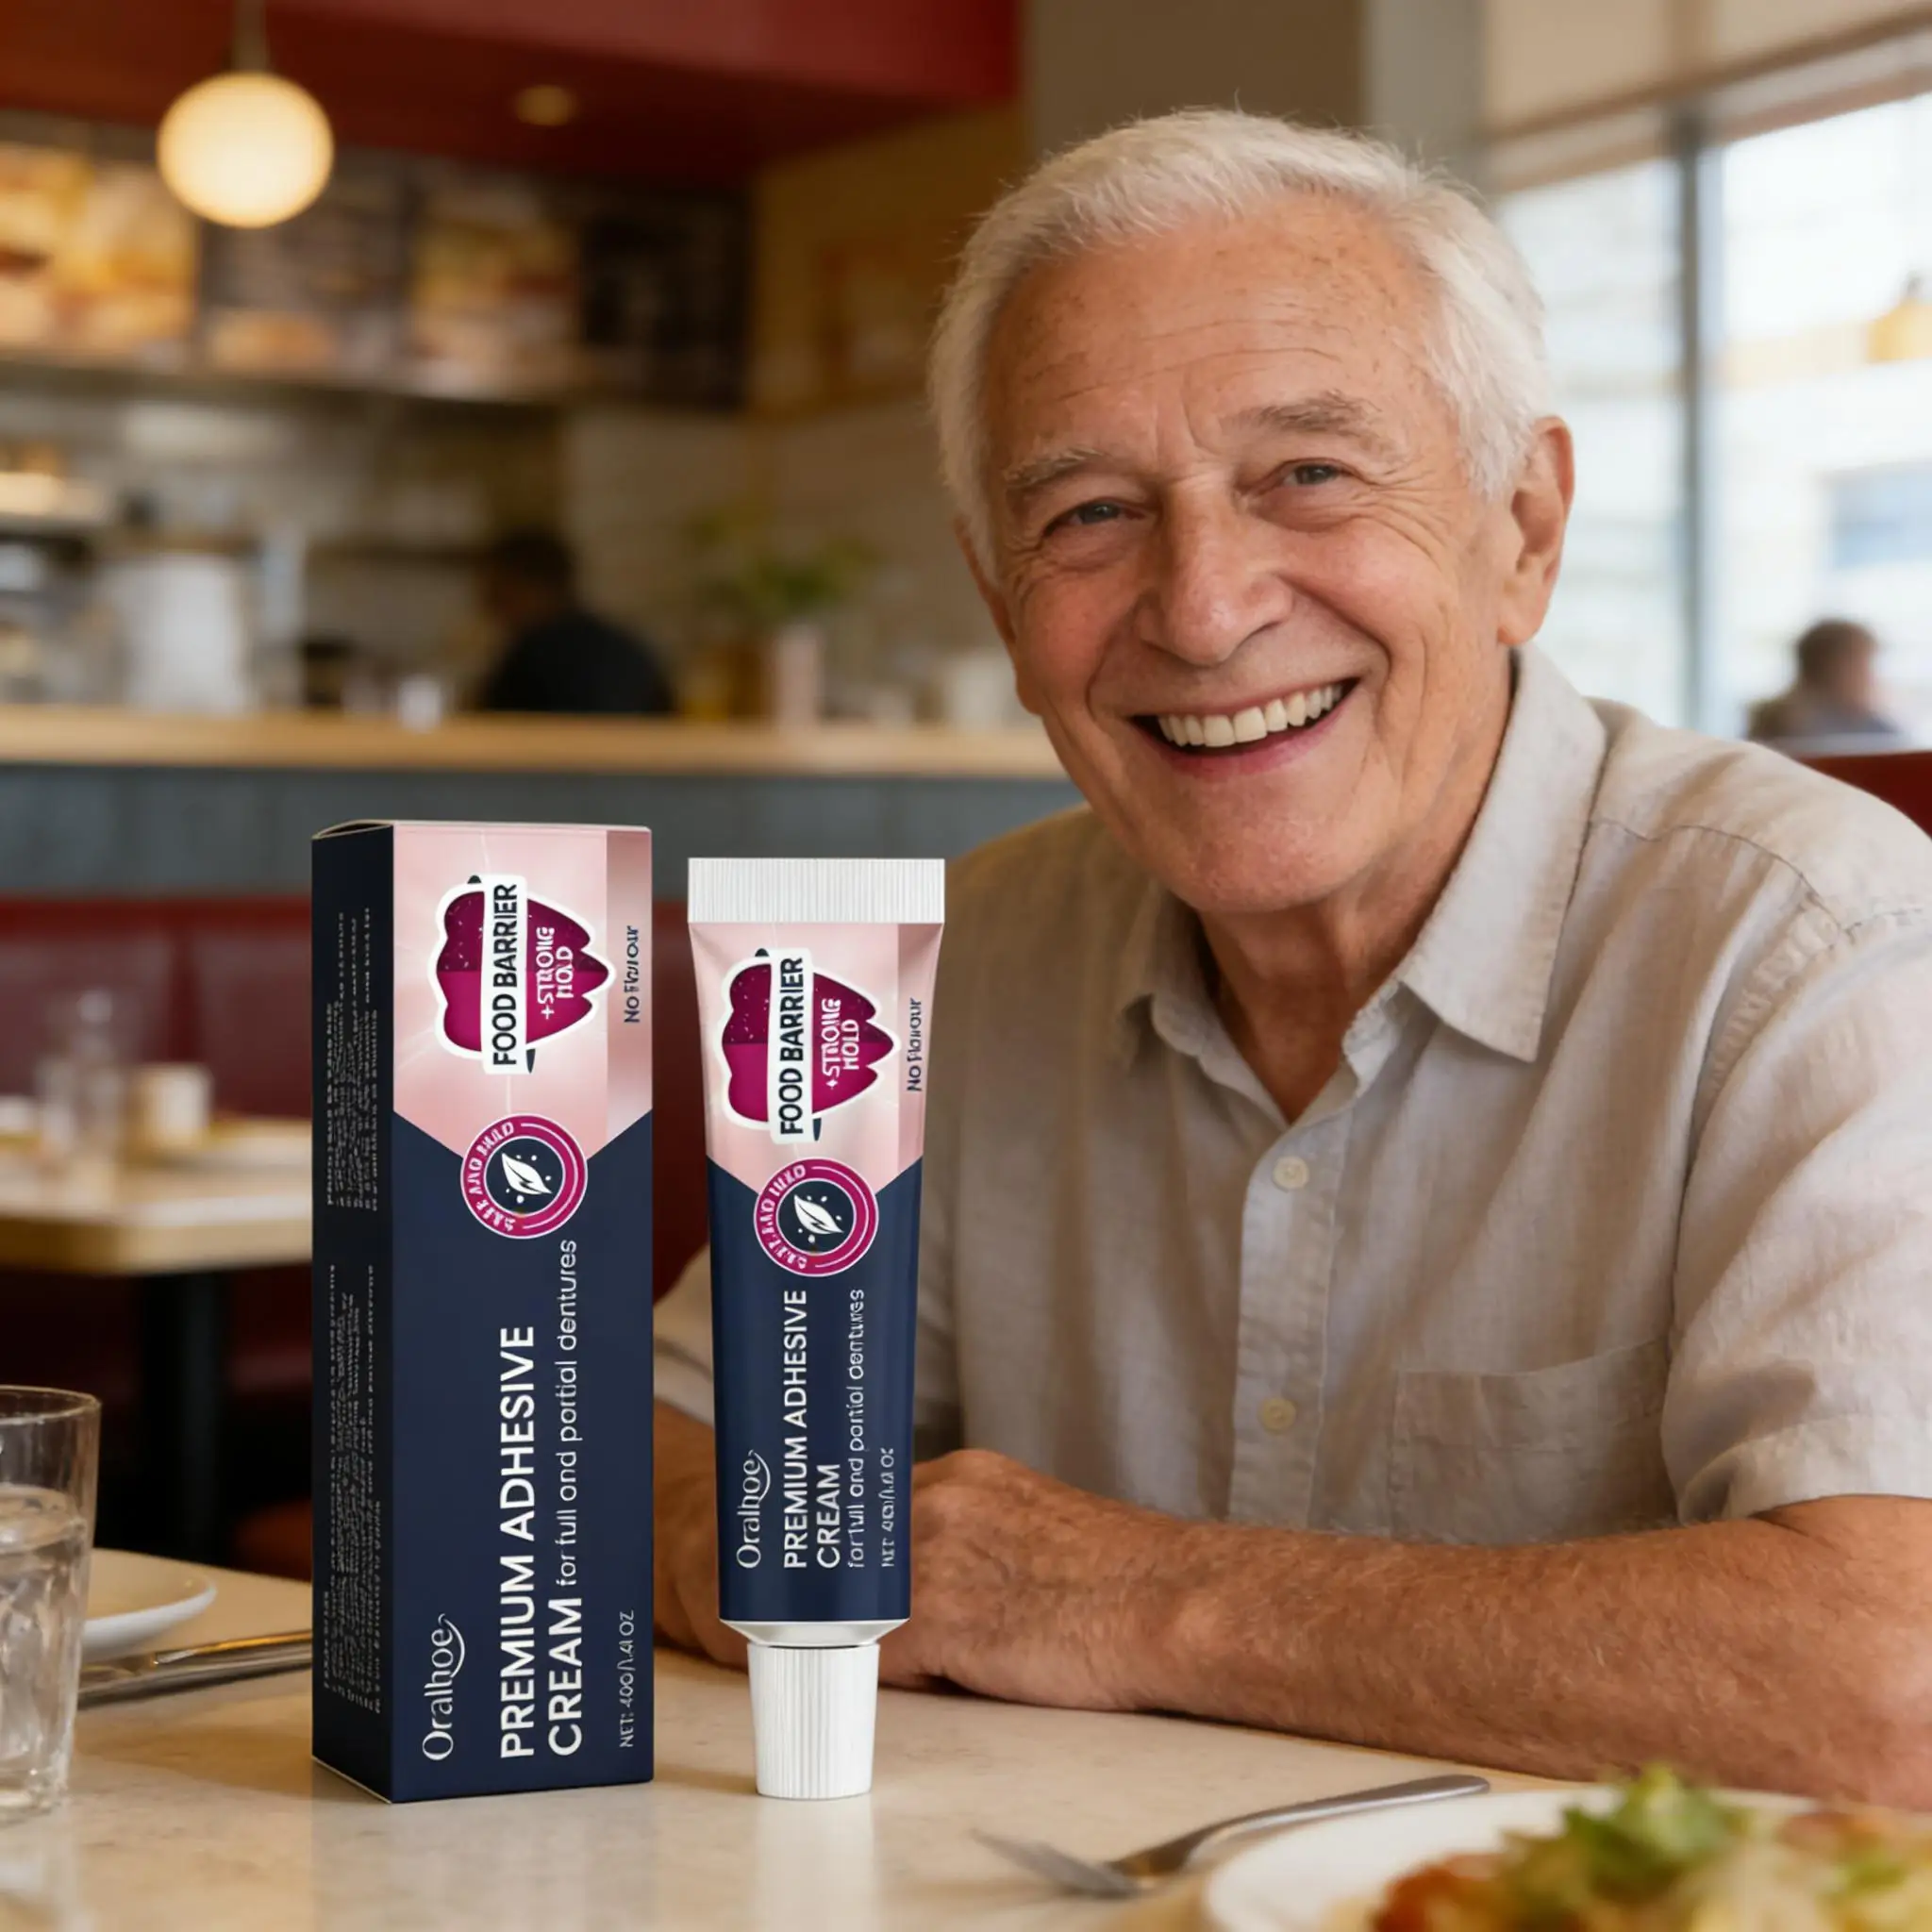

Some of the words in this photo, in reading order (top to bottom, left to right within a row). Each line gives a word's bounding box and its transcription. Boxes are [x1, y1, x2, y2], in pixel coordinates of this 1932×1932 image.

[492, 884, 518, 988] BARRIER
[492, 993, 517, 1066] FOOD
[624, 996, 640, 1024] No
[779, 958, 804, 1061] BARRIER
[841, 1018, 859, 1071] HOLD
[778, 1067, 804, 1135] FOOD
[907, 1065, 923, 1092] No
[555, 1240, 577, 1350] dentures
[783, 1290, 808, 1428] ADHESIVE
[499, 1326, 535, 1541] ADHESIVE
[556, 1509, 577, 1545] full
[784, 1436, 808, 1569] PREMIUM
[817, 1464, 841, 1569] CREAM
[556, 1554, 577, 1587] for
[847, 1541, 865, 1569] for
[499, 1554, 535, 1758] PREMIUM
[548, 1597, 583, 1757] CREAM
